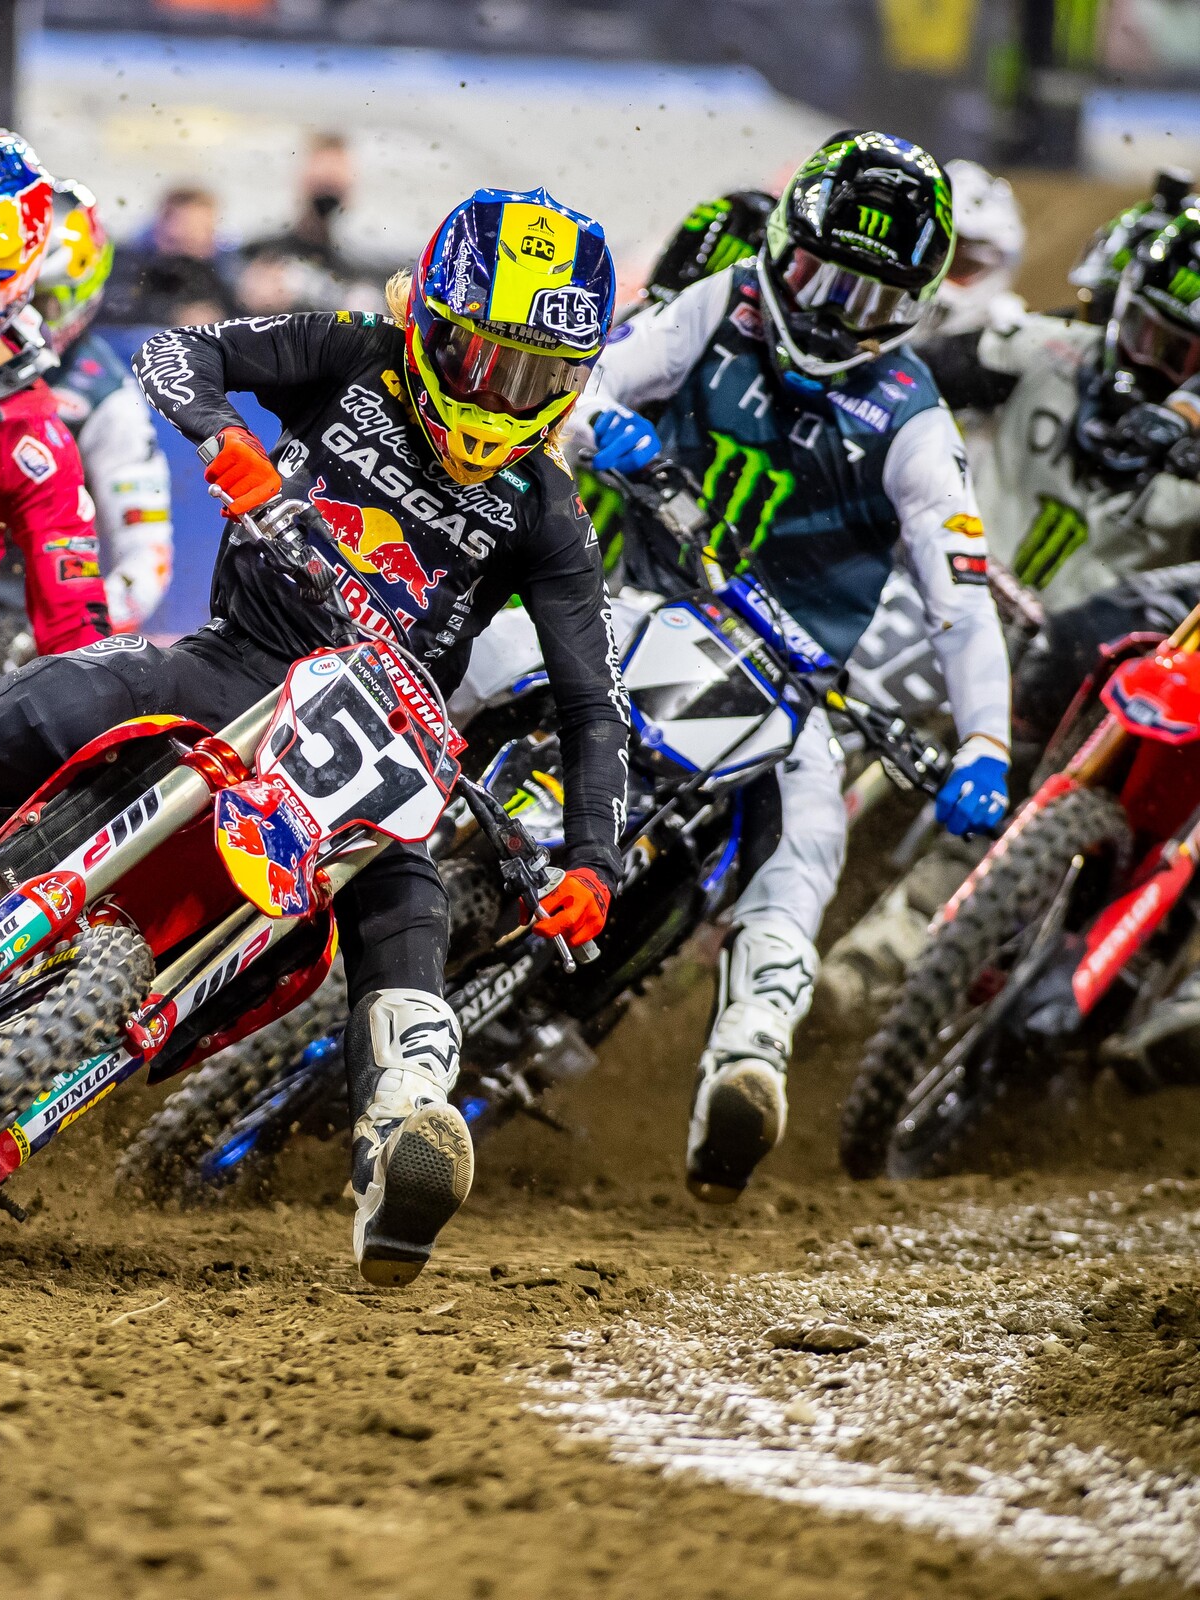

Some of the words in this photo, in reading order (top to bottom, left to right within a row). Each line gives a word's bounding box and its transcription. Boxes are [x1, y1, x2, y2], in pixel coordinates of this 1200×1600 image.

[522, 238, 554, 259] PPG
[477, 324, 505, 338] RACE
[511, 333, 557, 350] WHEELS
[340, 384, 394, 437] Troy
[378, 425, 421, 470] Lee
[321, 422, 497, 561] GASGAS
[499, 470, 529, 492] OREX
[341, 574, 418, 646] Bull
[317, 660, 336, 672] AMA
[355, 662, 395, 711] MONSTER
[271, 672, 429, 840] 51
[272, 778, 318, 836] GASGAS
[460, 954, 534, 1029] NLOP
[43, 1052, 121, 1127] DUNLOP
[11, 1122, 31, 1167] CERB
